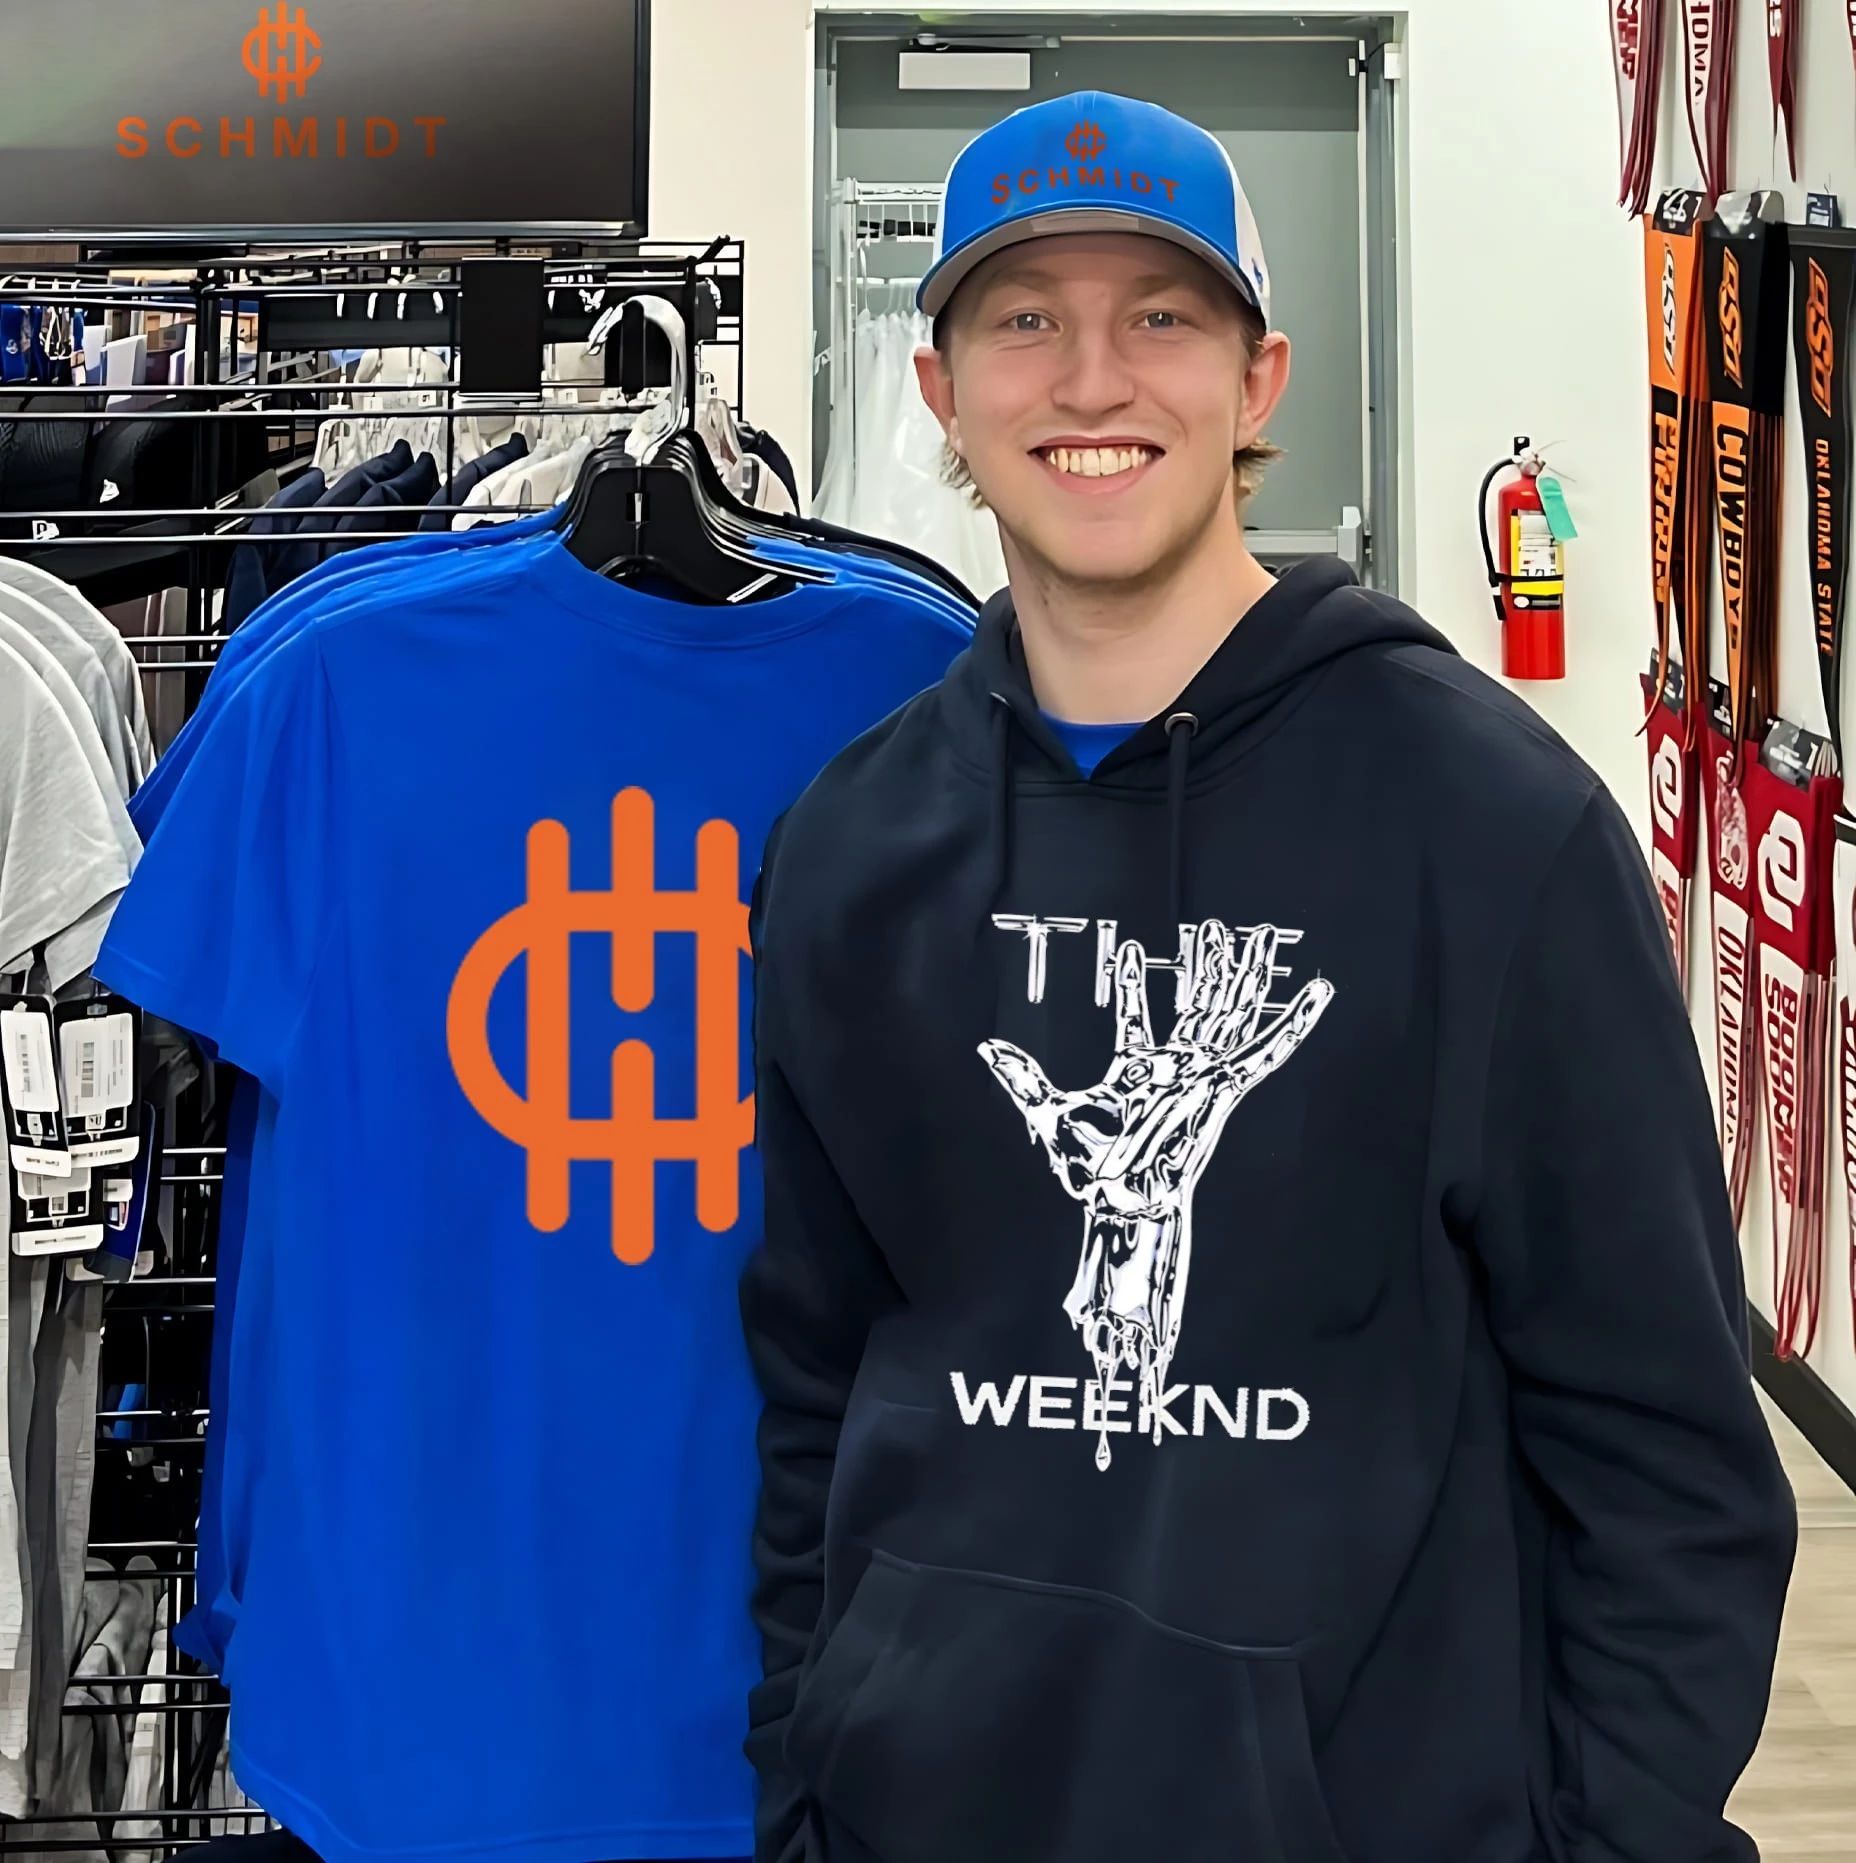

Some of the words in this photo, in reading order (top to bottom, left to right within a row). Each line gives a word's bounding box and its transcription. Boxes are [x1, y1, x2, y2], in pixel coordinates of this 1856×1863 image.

[116, 115, 448, 159] SCHMIDT
[991, 163, 1181, 206] SCHMIDT
[1814, 438, 1832, 570] OKLAHOMA
[1816, 582, 1835, 657] STATE
[991, 913, 1305, 1014] THE
[1718, 926, 1745, 1145] OKLAHOMA
[949, 1371, 1310, 1442] WEEKND
